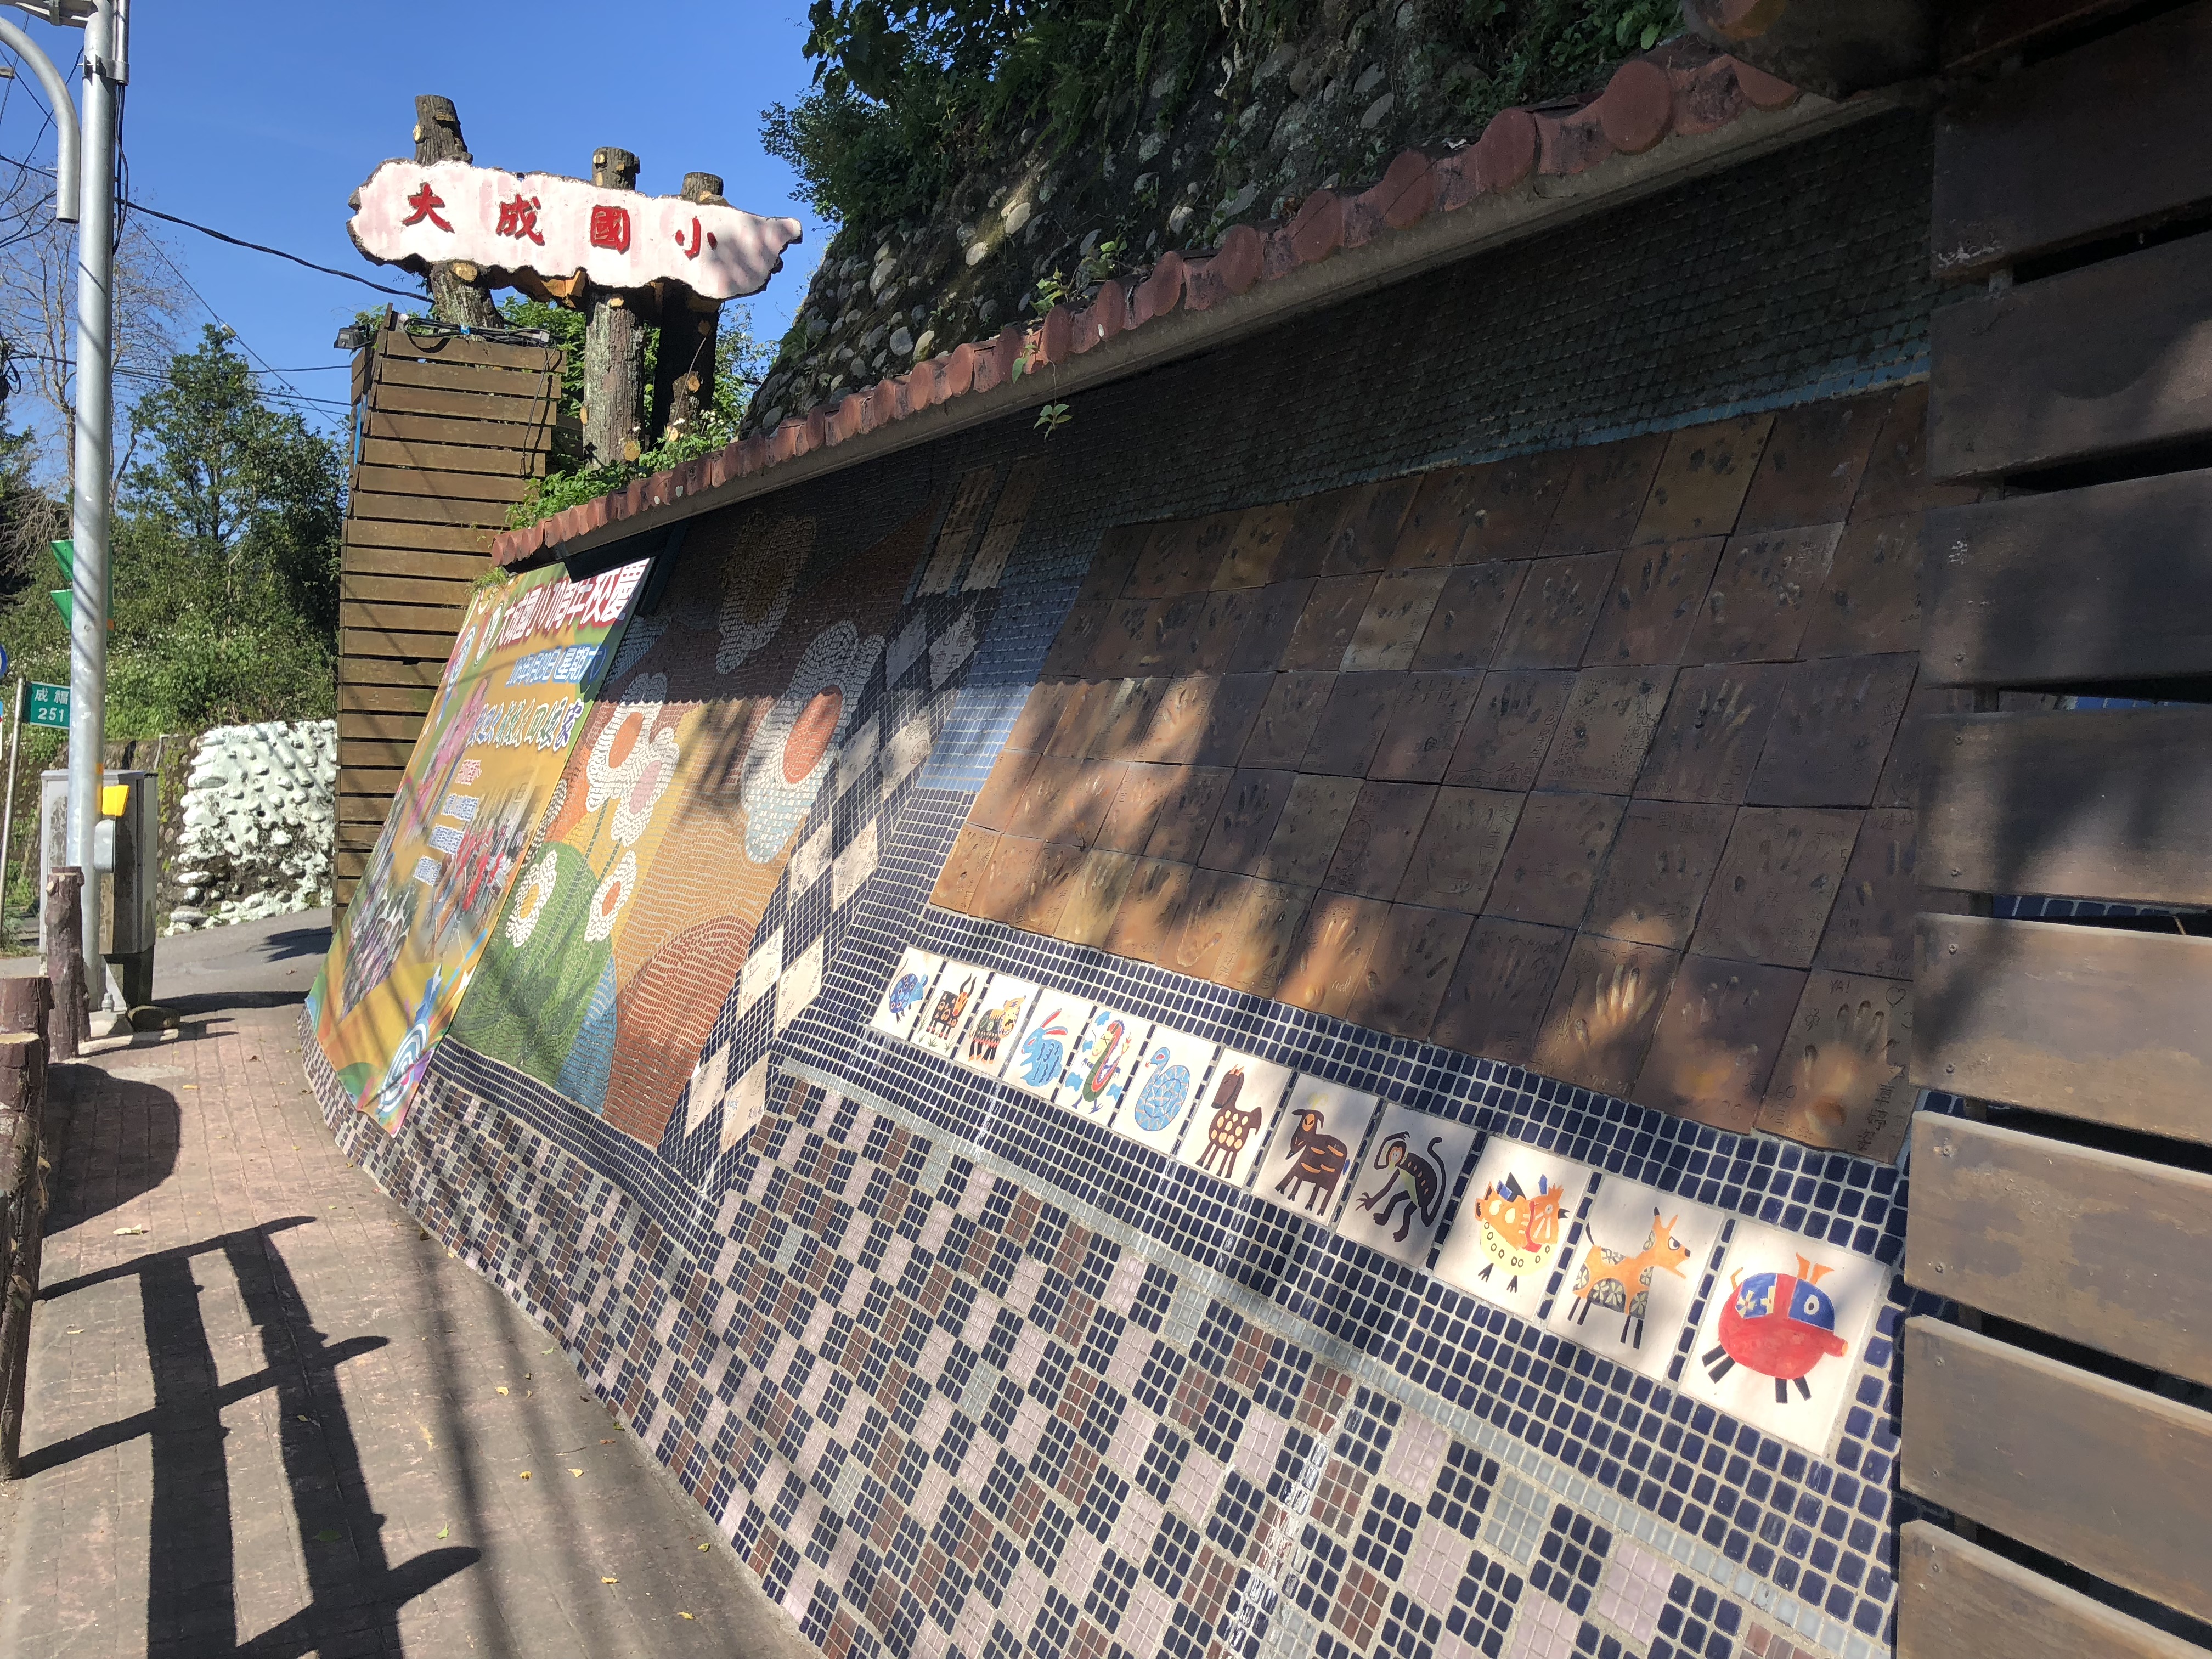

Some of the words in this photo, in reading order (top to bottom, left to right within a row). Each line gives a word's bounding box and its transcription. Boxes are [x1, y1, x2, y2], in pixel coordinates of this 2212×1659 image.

[403, 182, 717, 259] 大成國小
[34, 687, 69, 705] 成福
[37, 707, 64, 723] 251
